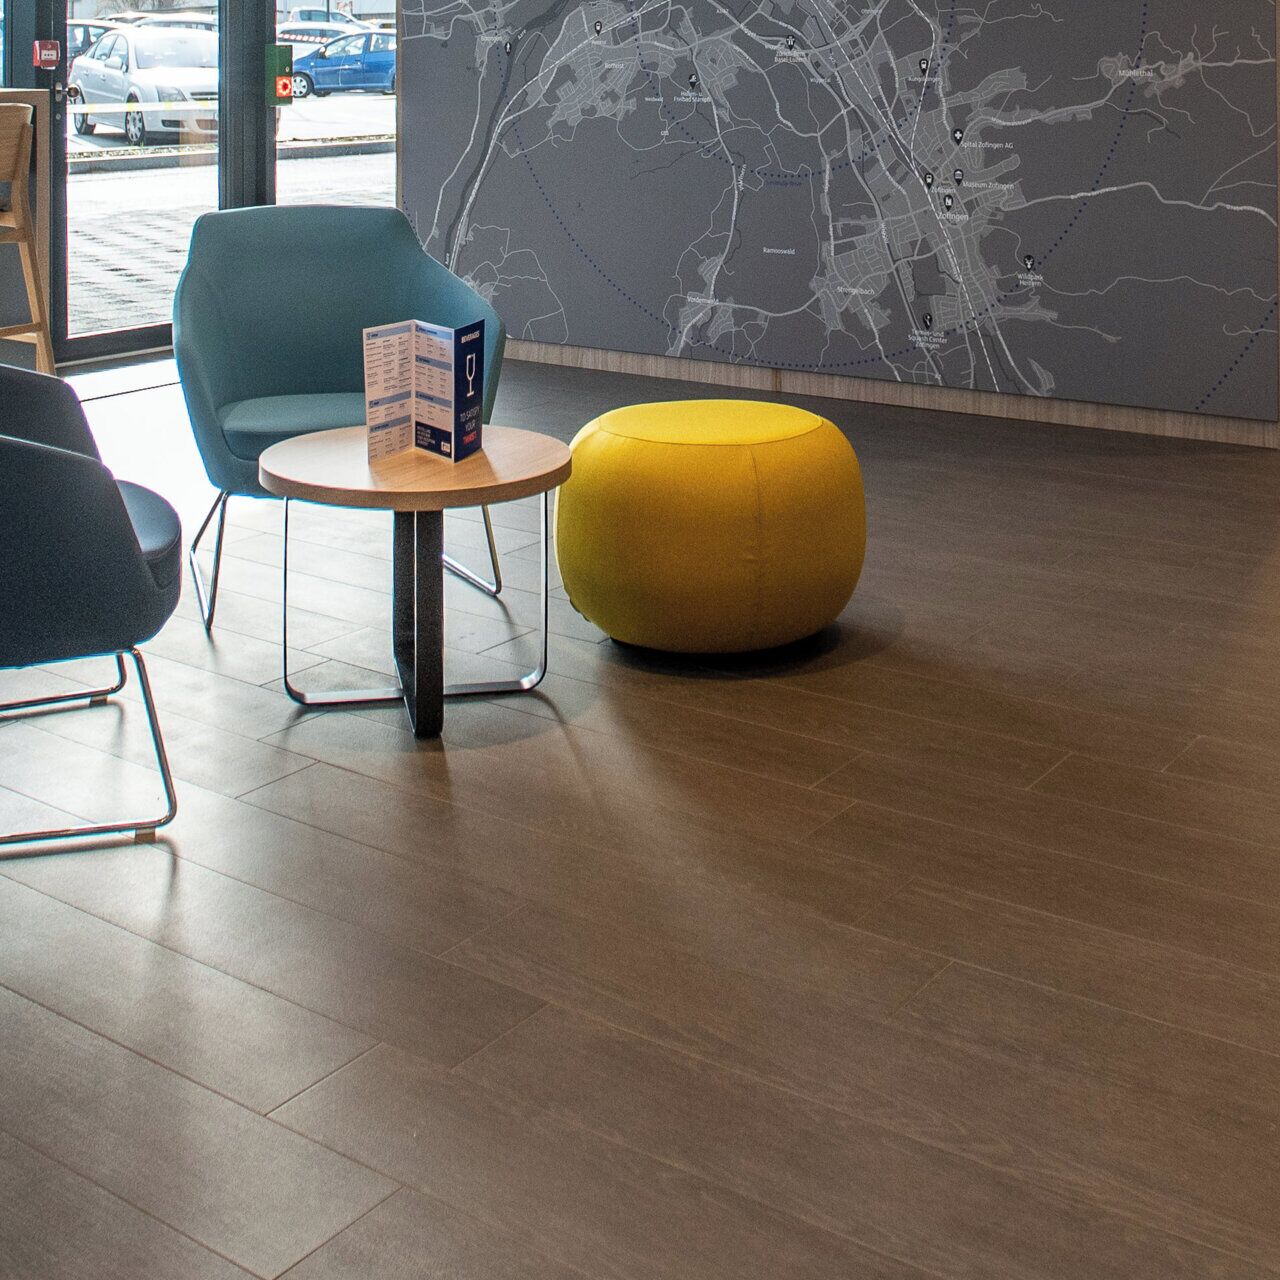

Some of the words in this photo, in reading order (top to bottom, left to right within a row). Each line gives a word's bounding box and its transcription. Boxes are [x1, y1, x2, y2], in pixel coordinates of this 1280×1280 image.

[1118, 69, 1154, 77] Mühlethal
[978, 141, 1004, 150] Zofingen
[963, 181, 988, 189] Museum
[989, 182, 1014, 191] Zofingen
[938, 212, 969, 221] Zofingen
[837, 285, 875, 295] Strengelbach
[928, 336, 948, 344] Center
[465, 421, 476, 432] YOUR
